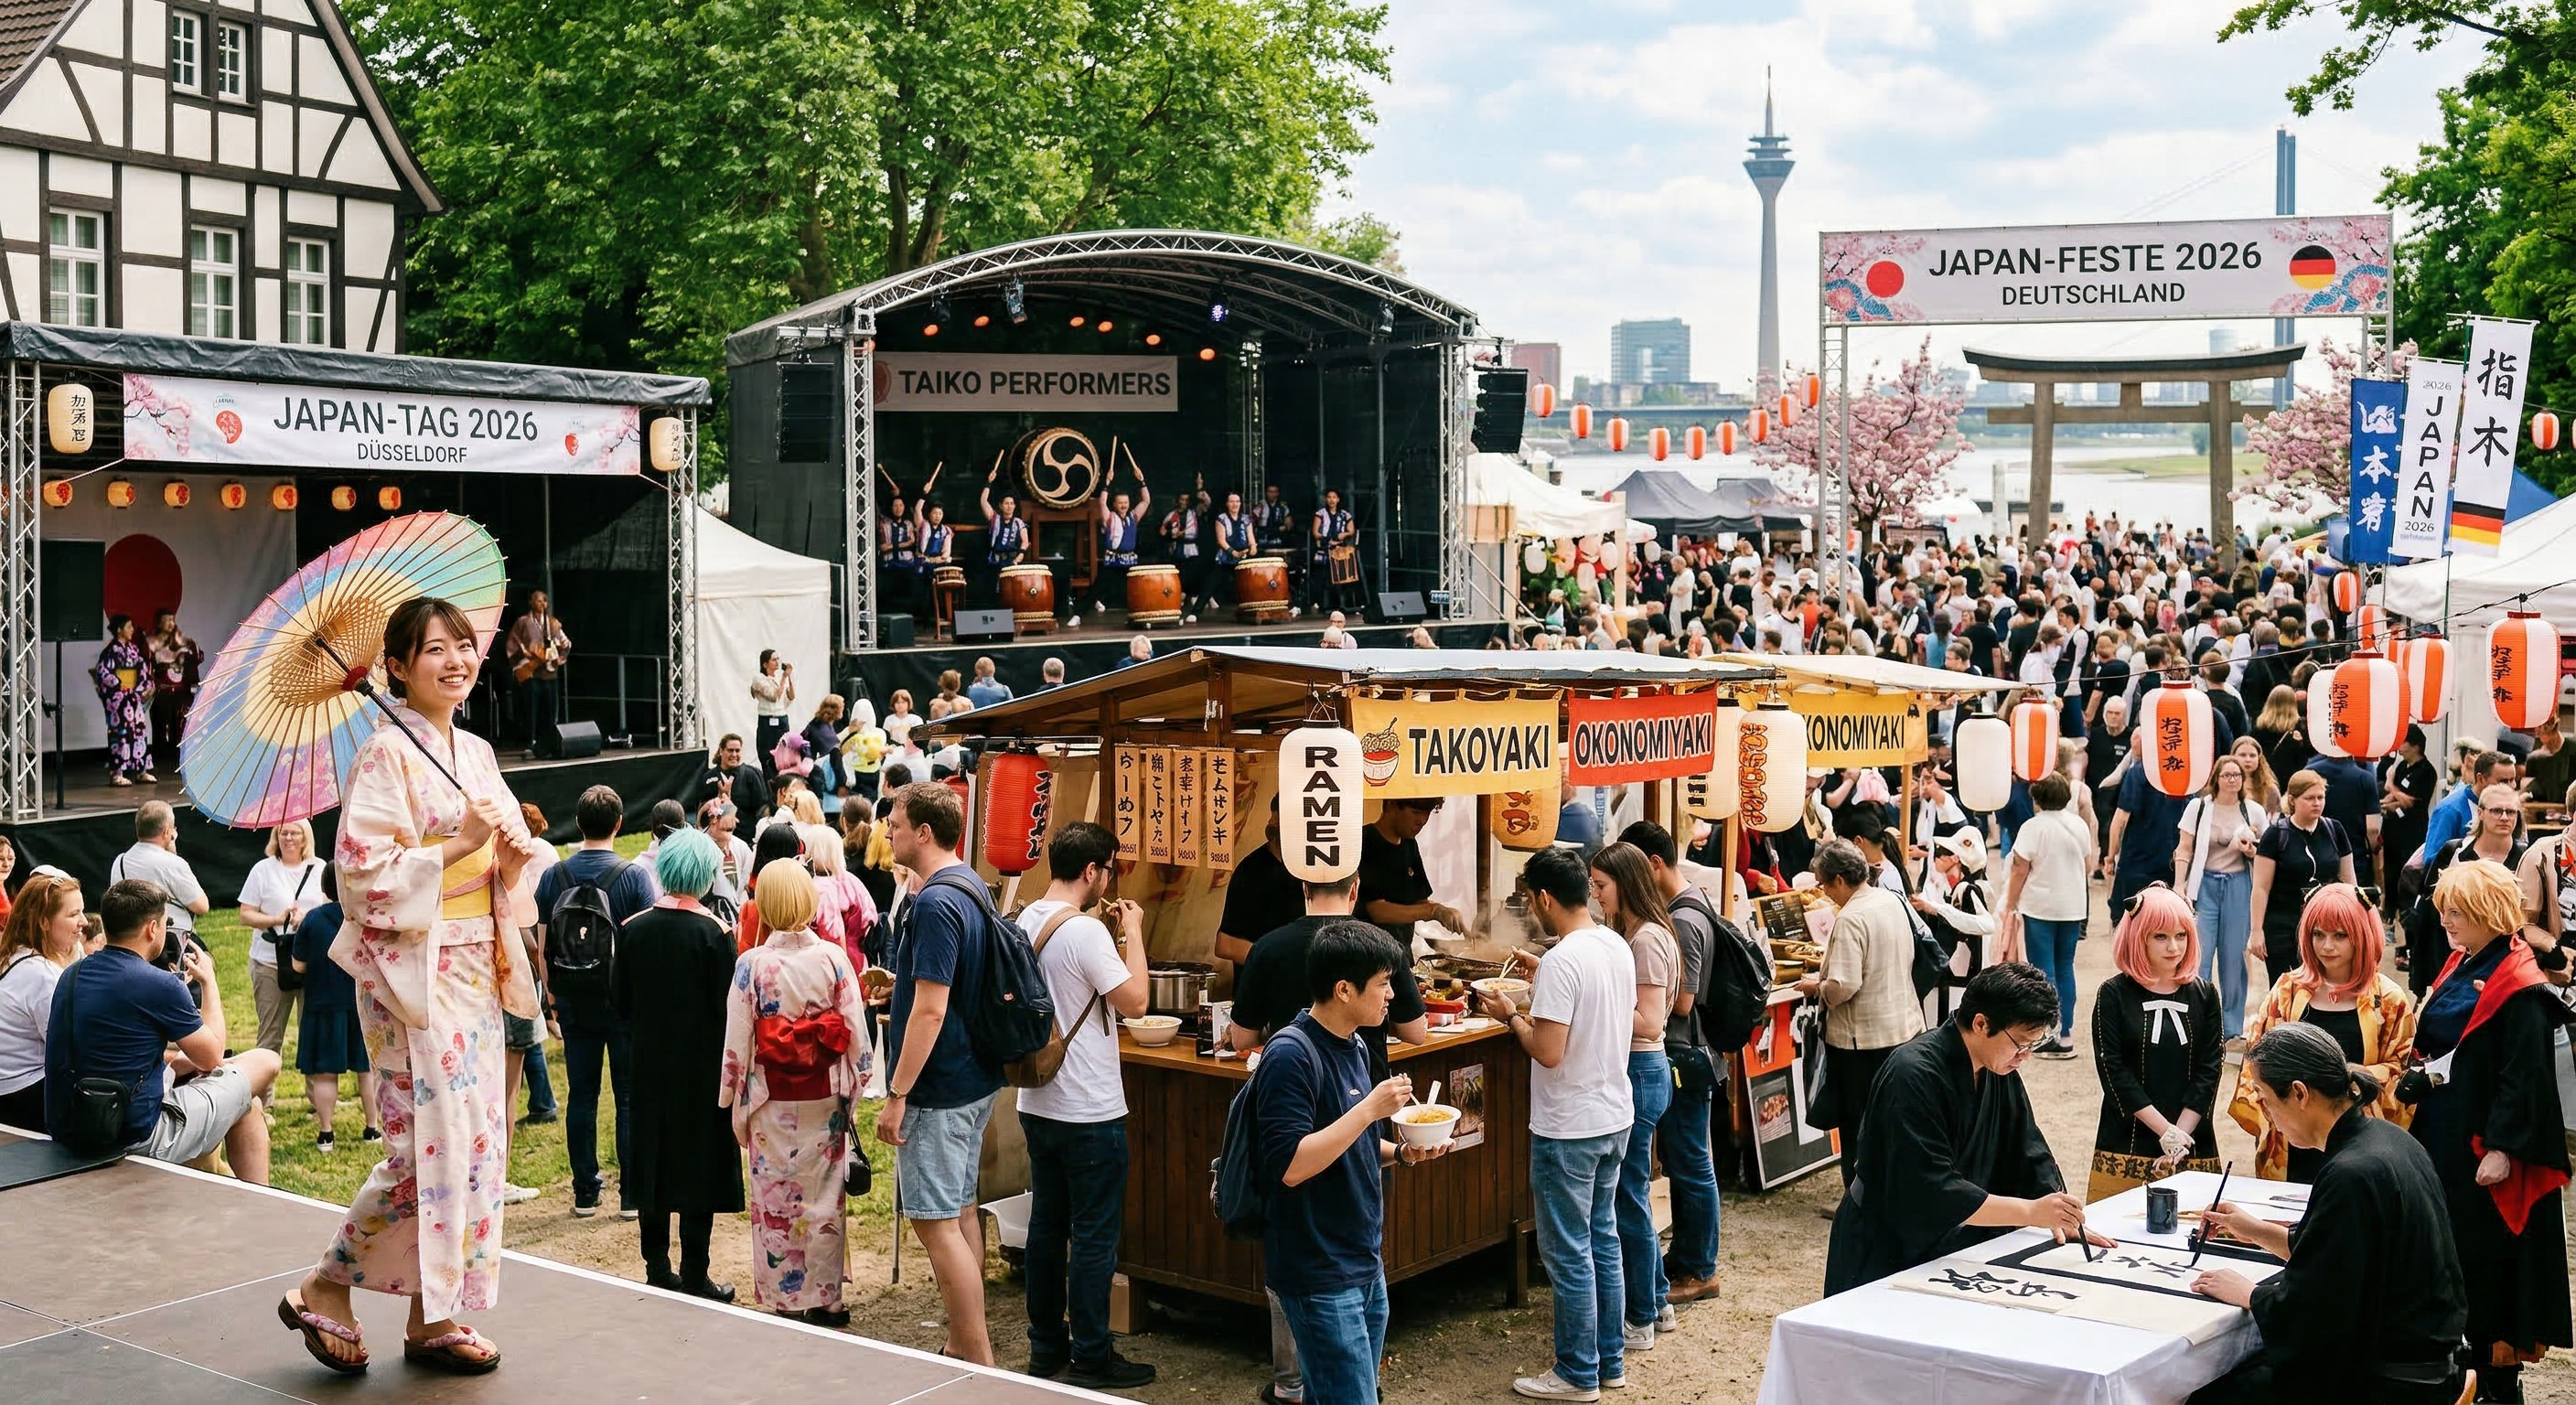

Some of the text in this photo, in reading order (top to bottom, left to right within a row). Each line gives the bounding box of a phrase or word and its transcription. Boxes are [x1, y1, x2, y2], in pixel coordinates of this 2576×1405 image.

[1928, 241, 2262, 276] JAPAN-FESTE 2026
[2002, 283, 2185, 306] DEUTSCHLAND
[897, 370, 1171, 396] TAIKO PERFORMERS
[274, 396, 538, 441] JAPAN-TAG 2026
[357, 439, 467, 464] DÜSSELDORF
[2410, 395, 2443, 519] JAPAN
[2404, 520, 2435, 533] 2026
[1408, 724, 1550, 775] TAKOYAKI
[1574, 714, 1712, 767] OKONOMIYAKI
[1302, 746, 1341, 867] RAMEN
